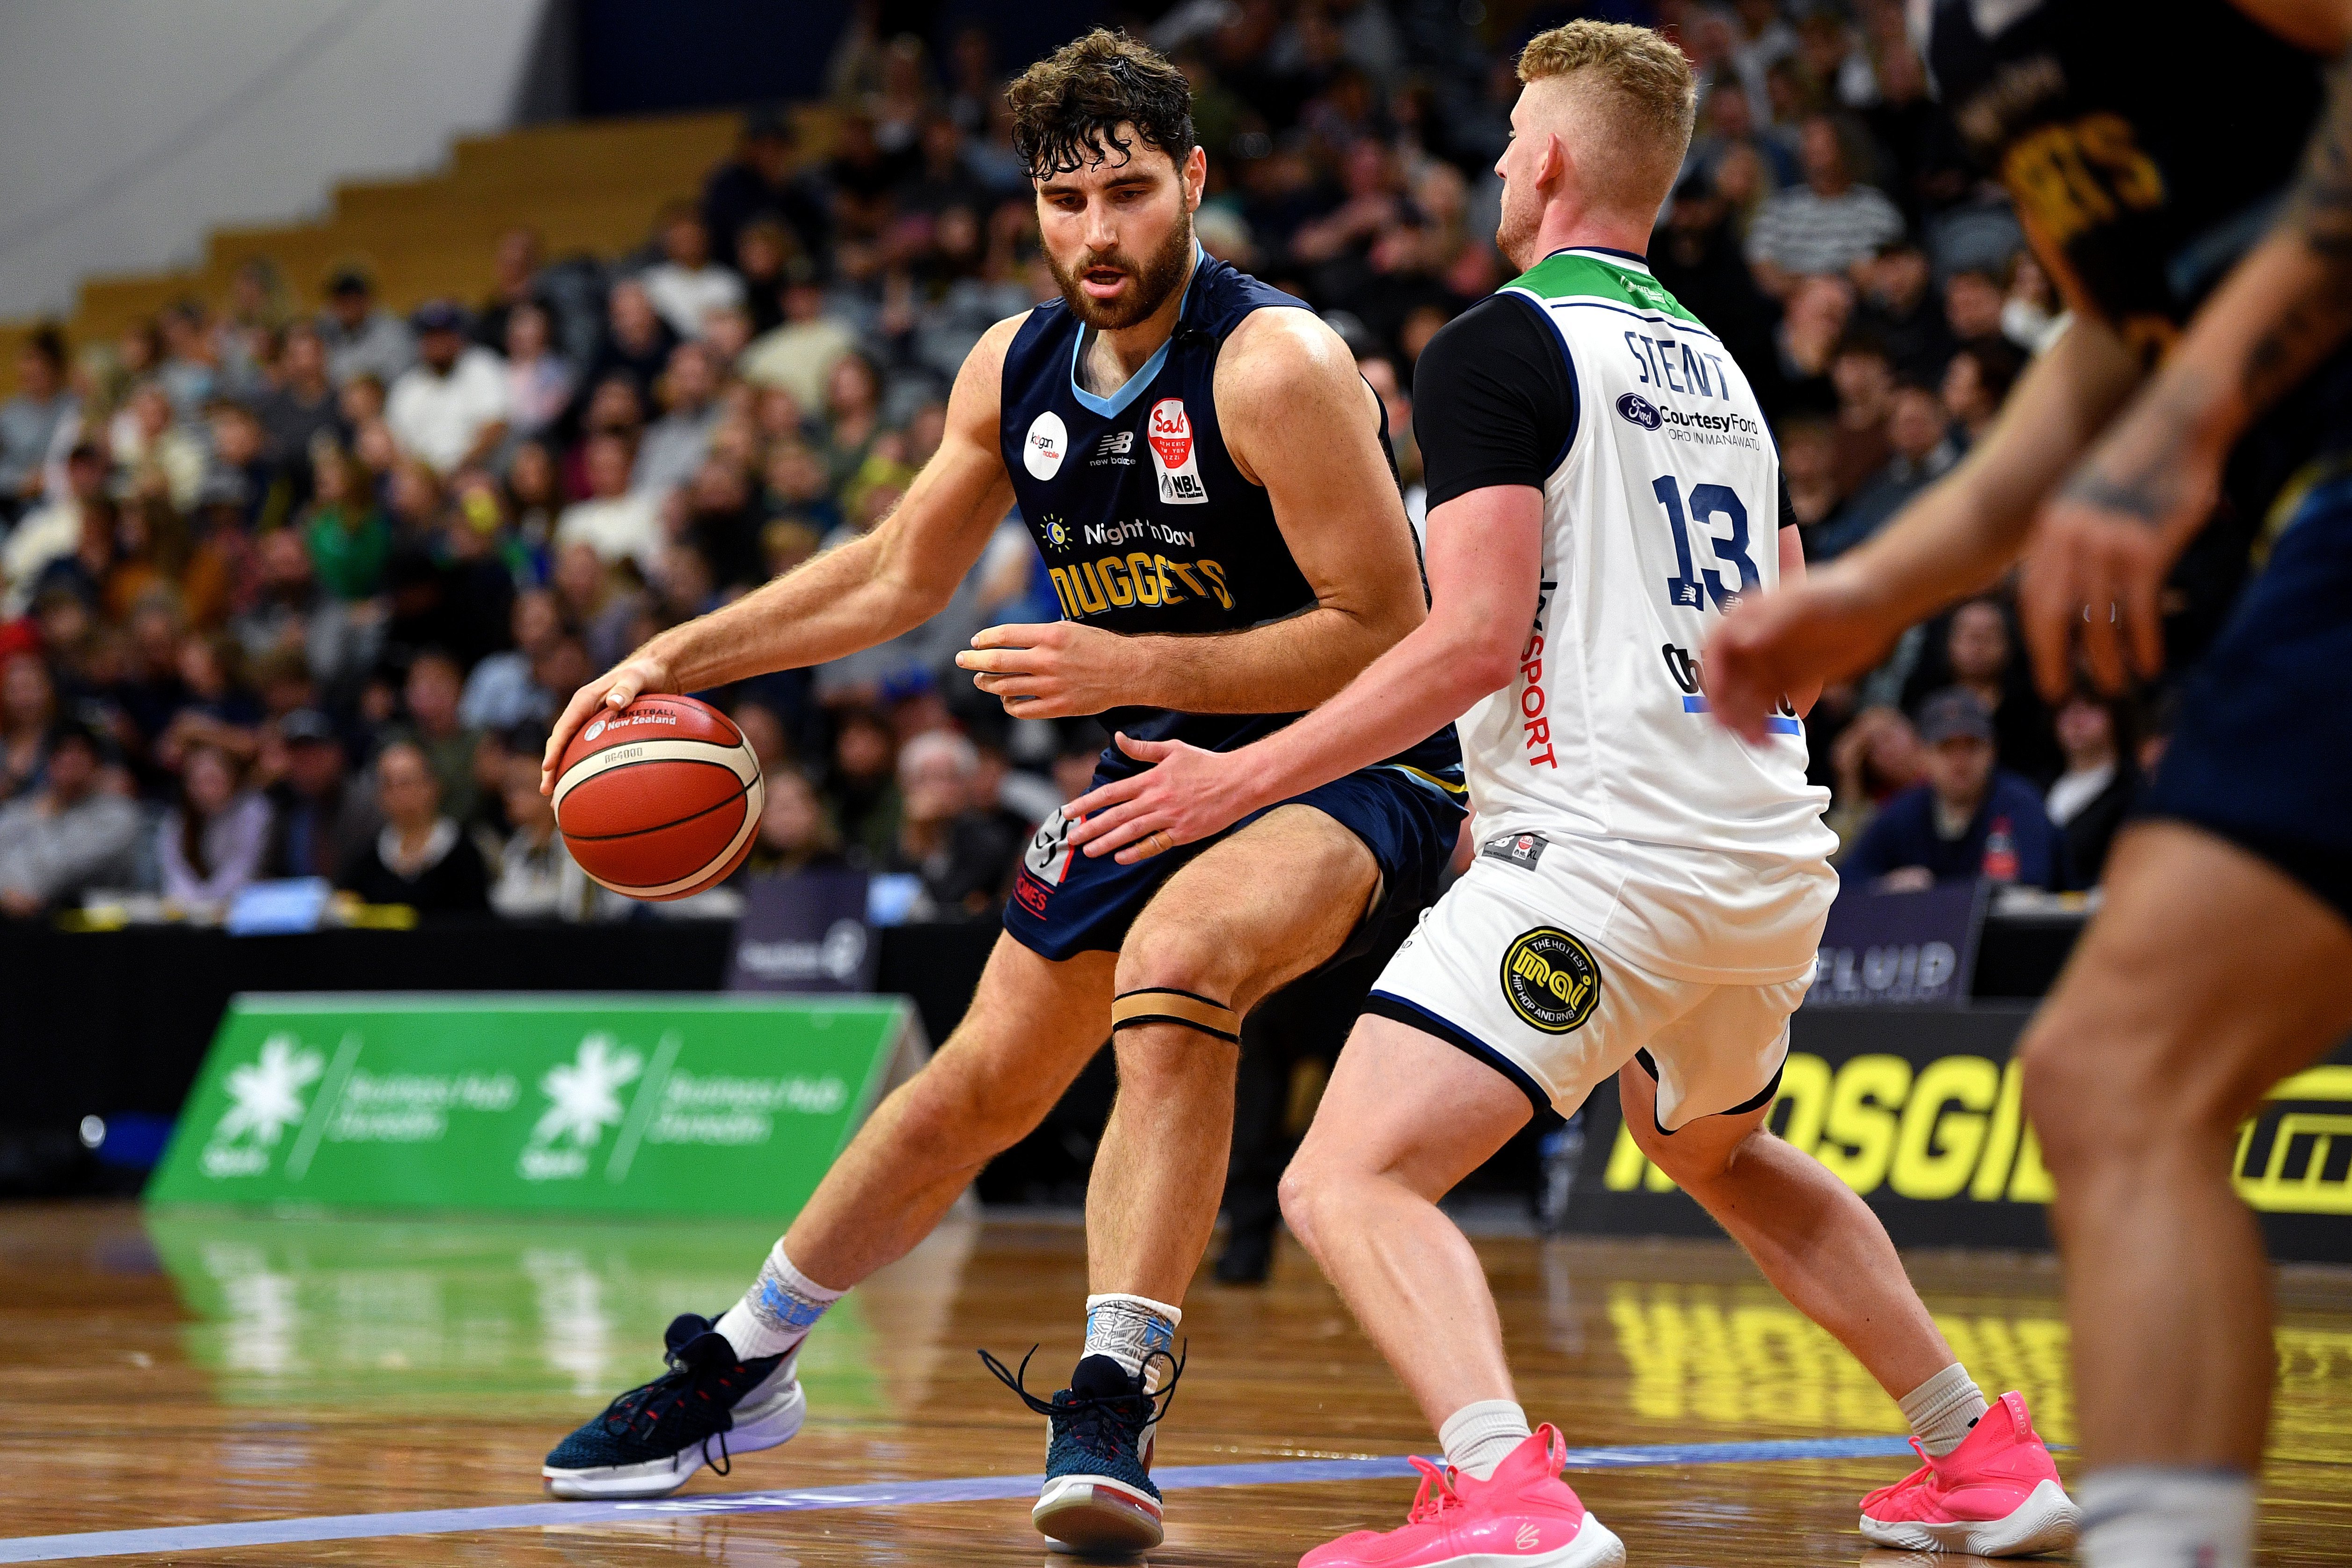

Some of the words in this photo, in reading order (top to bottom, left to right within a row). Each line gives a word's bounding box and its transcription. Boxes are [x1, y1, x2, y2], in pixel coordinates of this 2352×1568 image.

[1624, 331, 1730, 401] STENT
[1628, 397, 1653, 425] Ford
[1694, 432, 1704, 444] IN
[1706, 433, 1760, 451] MANAWATU
[1090, 458, 1108, 467] new
[1172, 474, 1202, 492] NBL
[1084, 518, 1143, 545] Night
[1160, 524, 1195, 547] Day
[1652, 474, 1764, 617] 13
[1049, 552, 1235, 621] NUGGETS
[1520, 634, 1558, 769] SPORT
[607, 718, 630, 731] New
[632, 715, 677, 725] Zealand
[604, 747, 643, 764] BG4000
[1527, 848, 1537, 861] XL
[1531, 939, 1551, 951] THE
[1552, 940, 1588, 972] HOTTEST
[1512, 946, 1591, 1011] mai
[1512, 974, 1523, 991] HIP
[1517, 992, 1536, 1010] HOP
[1534, 1008, 1555, 1021] AND
[1556, 1010, 1575, 1022] RNB
[2010, 1399, 2028, 1435] CURRY
